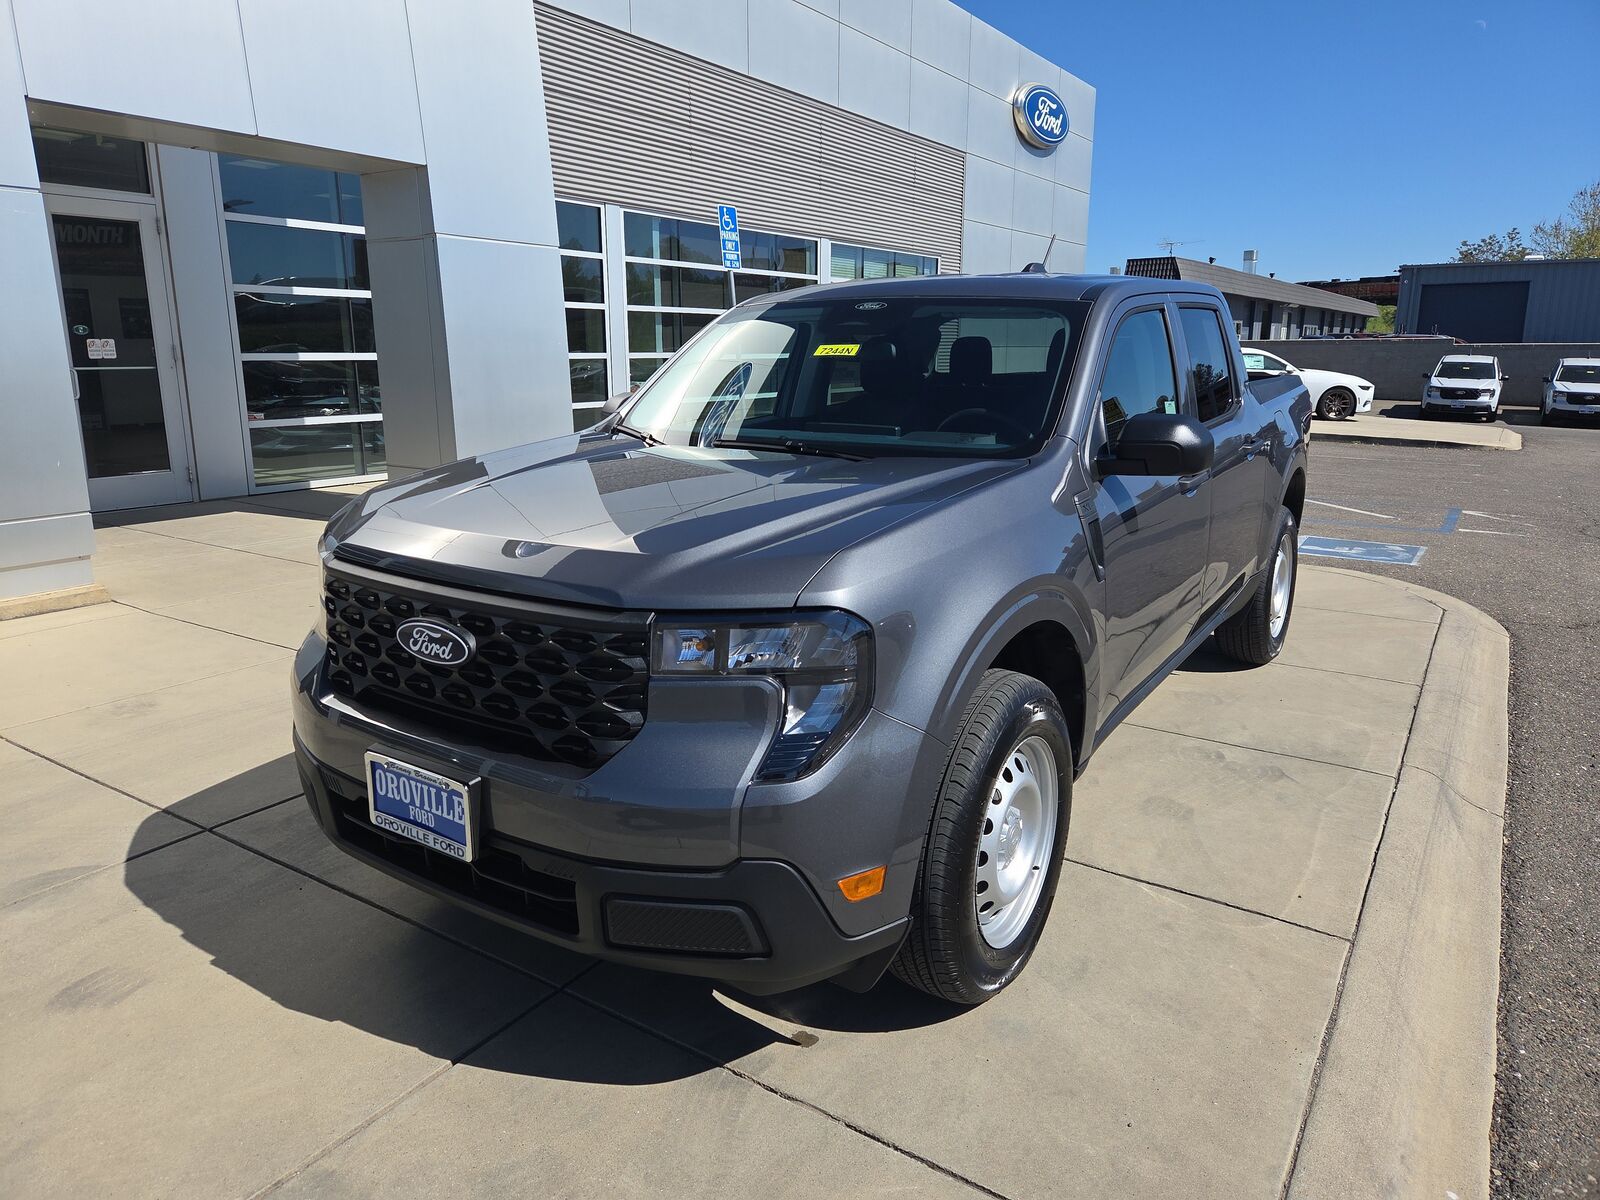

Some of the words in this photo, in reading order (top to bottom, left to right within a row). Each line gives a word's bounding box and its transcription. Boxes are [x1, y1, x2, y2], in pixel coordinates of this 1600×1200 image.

[1034, 96, 1063, 135] Ford
[56, 223, 124, 244] MONTH
[720, 230, 738, 240] PARKING
[725, 240, 736, 251] ONLY
[819, 347, 854, 355] 7244N
[409, 627, 453, 660] Ford
[389, 762, 411, 776] Benny
[375, 768, 465, 825] OROVILLE
[408, 804, 435, 828] FORD
[375, 815, 431, 844] OROVILLE
[432, 836, 465, 858] FORD
